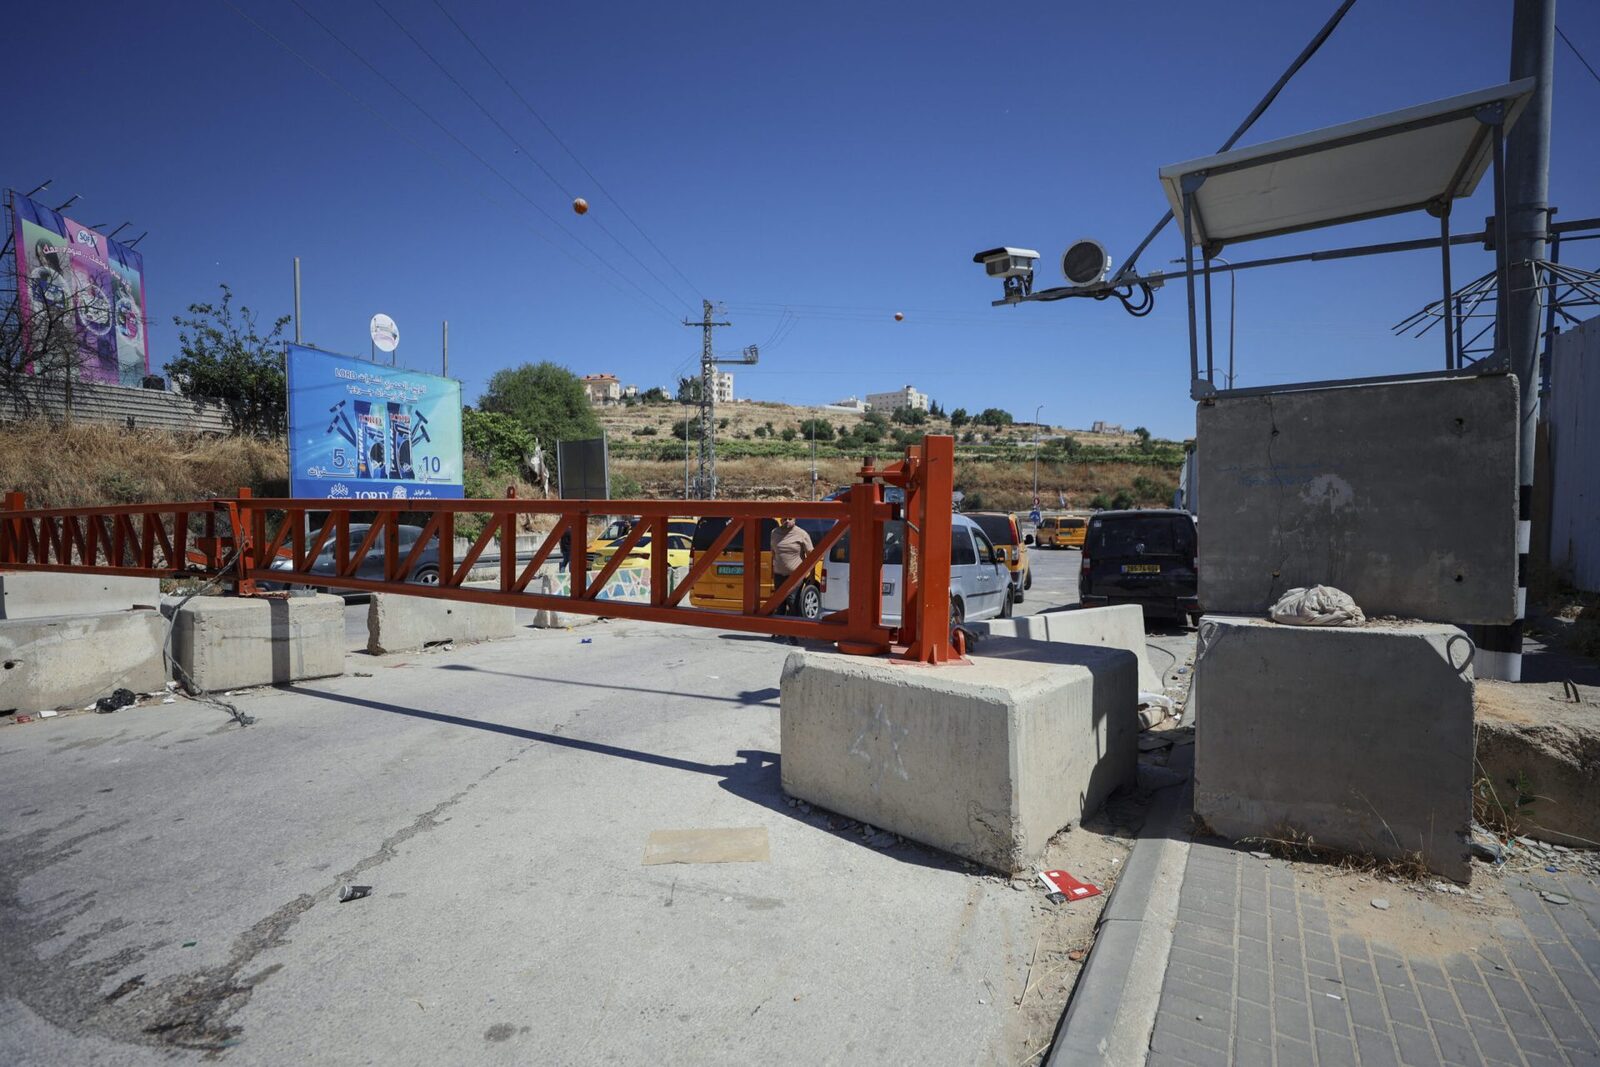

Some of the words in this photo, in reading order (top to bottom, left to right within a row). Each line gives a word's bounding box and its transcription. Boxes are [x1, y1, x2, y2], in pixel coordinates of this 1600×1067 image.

[335, 367, 357, 380] LORD
[333, 449, 345, 468] 5
[422, 456, 441, 473] 10
